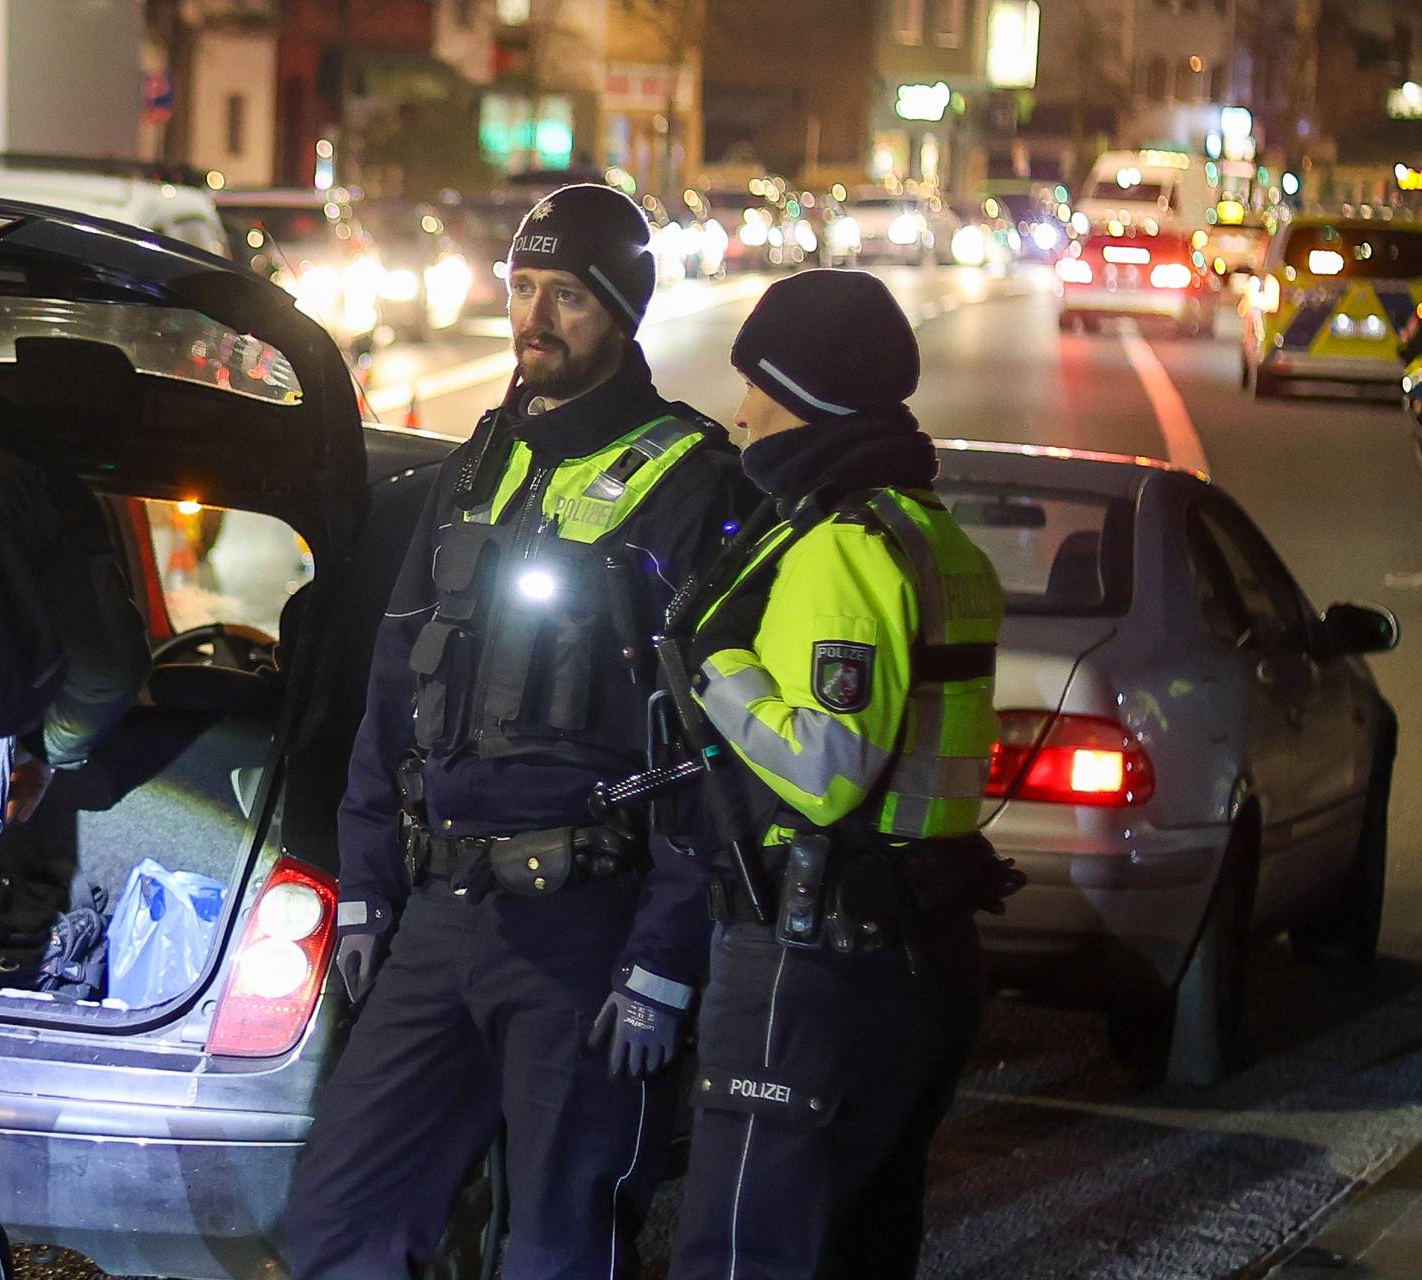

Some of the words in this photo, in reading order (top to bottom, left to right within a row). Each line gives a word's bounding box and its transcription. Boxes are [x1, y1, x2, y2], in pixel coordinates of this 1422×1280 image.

[515, 234, 558, 255] OLIZEI
[818, 647, 867, 661] POLIZE
[730, 1079, 791, 1104] POLIZEI
